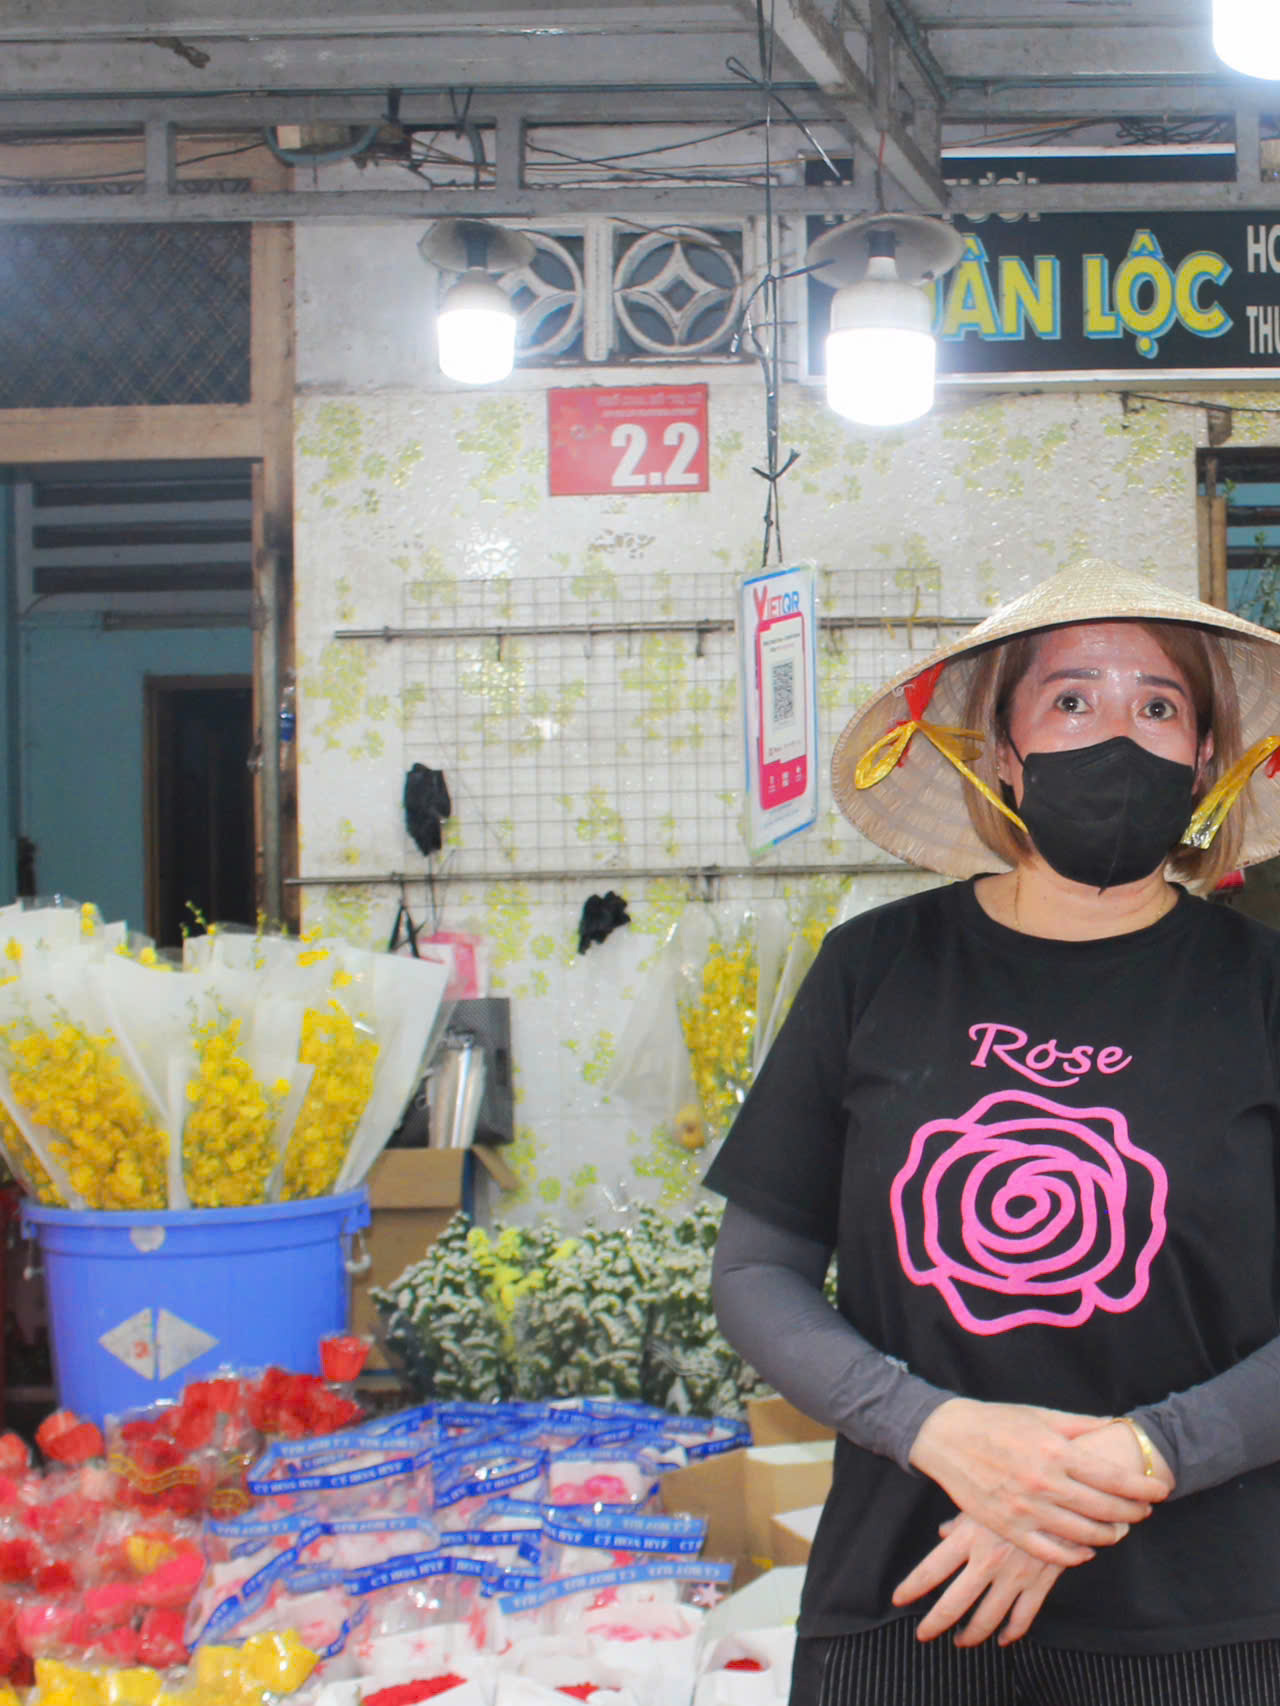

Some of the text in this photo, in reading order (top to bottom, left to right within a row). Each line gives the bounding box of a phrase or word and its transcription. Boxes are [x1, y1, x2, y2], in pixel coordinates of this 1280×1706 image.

[1081, 229, 1234, 359] LỘC
[610, 422, 701, 487] 2.2
[968, 1022, 1133, 1088] Rose
